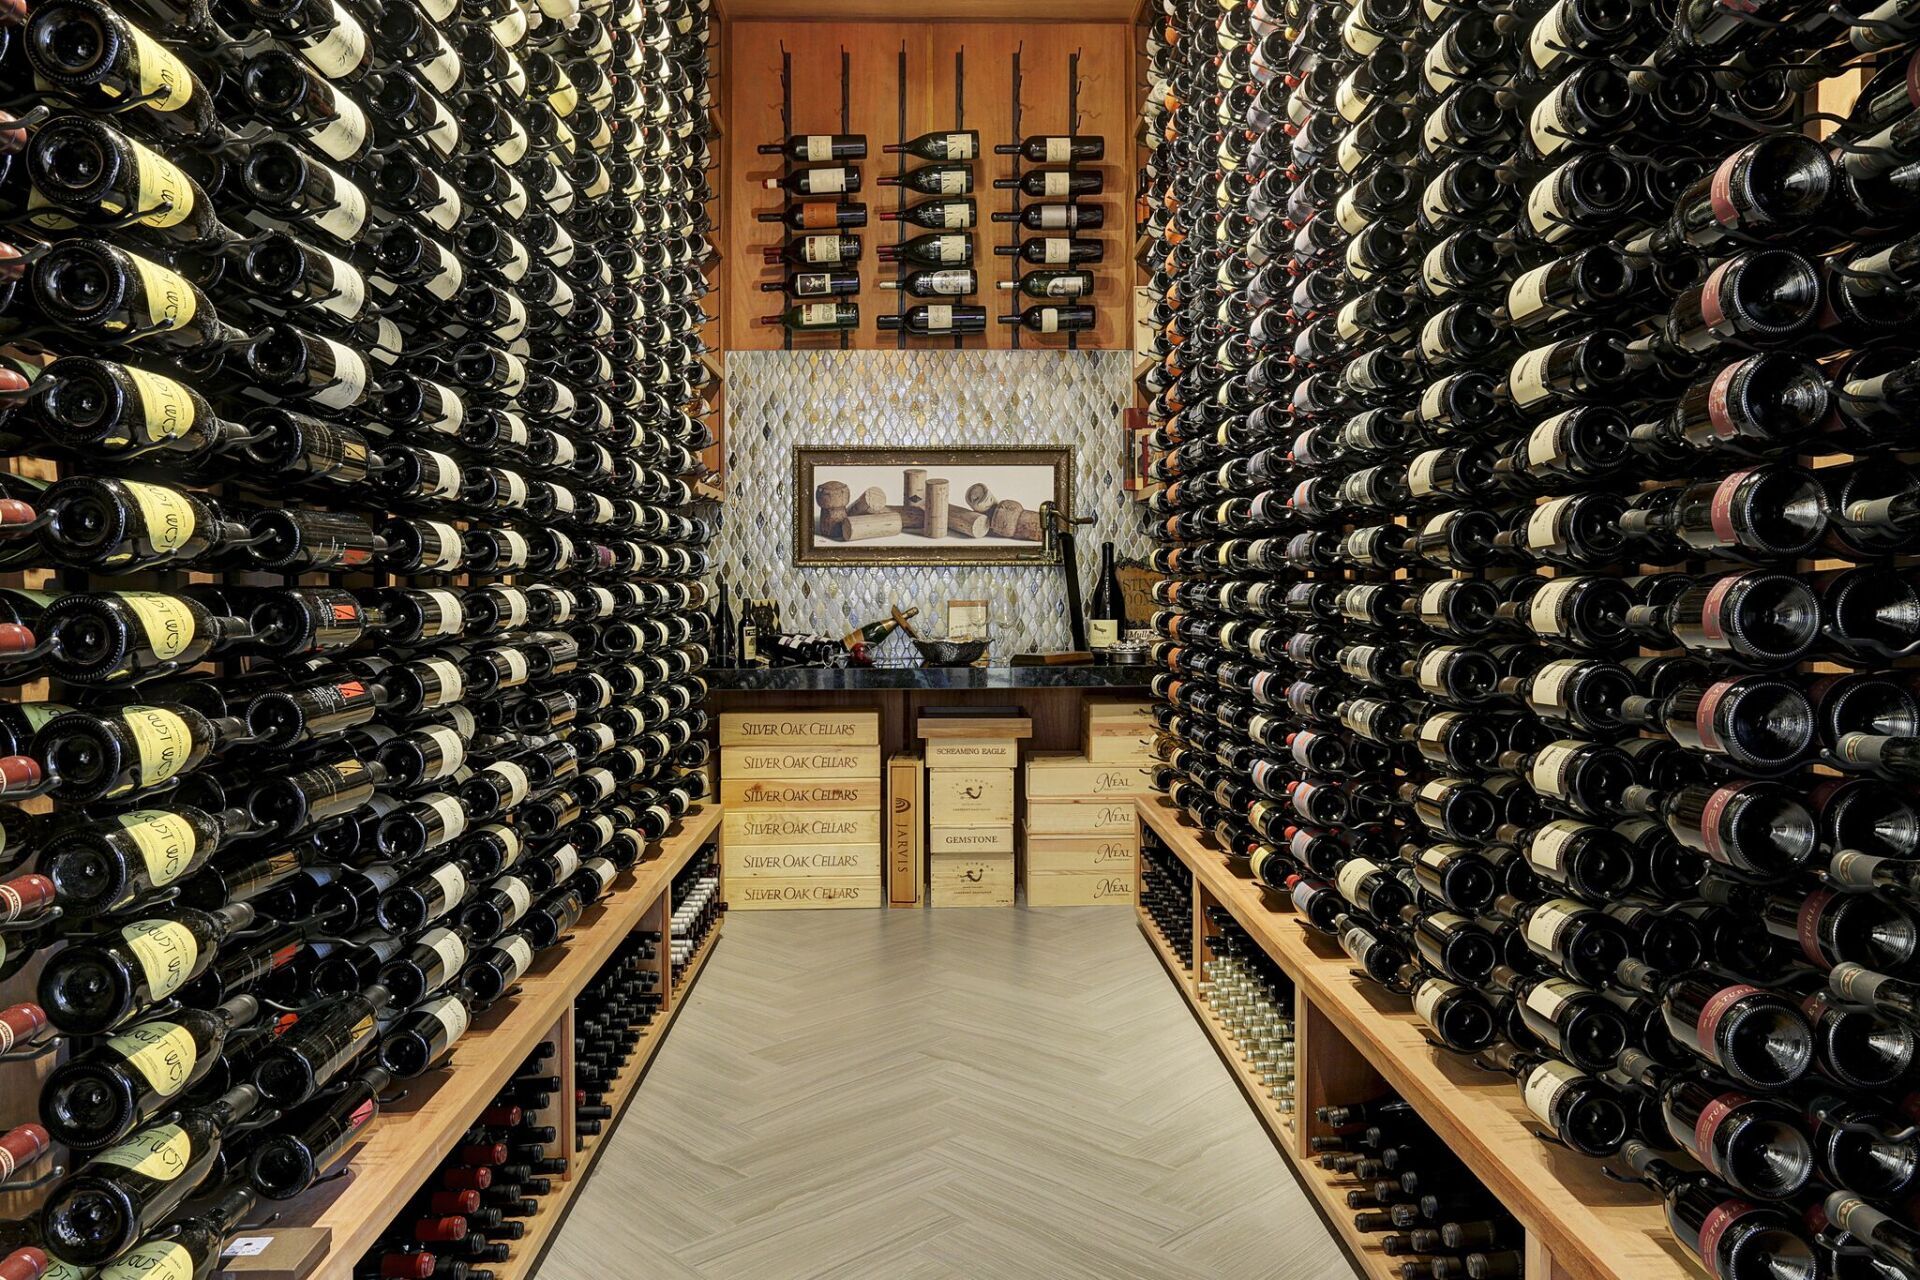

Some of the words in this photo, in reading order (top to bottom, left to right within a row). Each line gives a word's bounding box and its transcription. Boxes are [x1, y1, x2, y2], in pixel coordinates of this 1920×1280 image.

[742, 722, 779, 736] SILVER
[781, 721, 808, 736] OAK
[809, 721, 856, 736] CELLARS
[936, 747, 980, 756] SCREAMING
[981, 747, 1007, 756] EAGLE
[743, 755, 782, 770] SILVER
[782, 755, 810, 769] OAK
[811, 755, 859, 769] CELLARS
[1093, 771, 1134, 794] NEAL
[743, 788, 782, 803] SILVER
[782, 788, 810, 801] OAK
[811, 787, 859, 801] CELLARS
[1094, 806, 1134, 828] NEAL
[743, 821, 782, 836] SILVER
[782, 821, 810, 835] OAK
[811, 820, 859, 834] CELLARS
[945, 835, 999, 845] GEMSTONE
[895, 823, 909, 874] JARVIS
[1094, 842, 1134, 864] NEAL
[743, 854, 782, 869] SILVER
[782, 854, 811, 868] OAK
[812, 853, 859, 867] CELLARS
[744, 888, 783, 901] SILVER
[783, 886, 812, 901] OAK
[813, 886, 860, 900] CELLARS
[1093, 877, 1134, 899] NEAL
[163, 1050, 187, 1090] WEST
[150, 1140, 185, 1174] WEST
